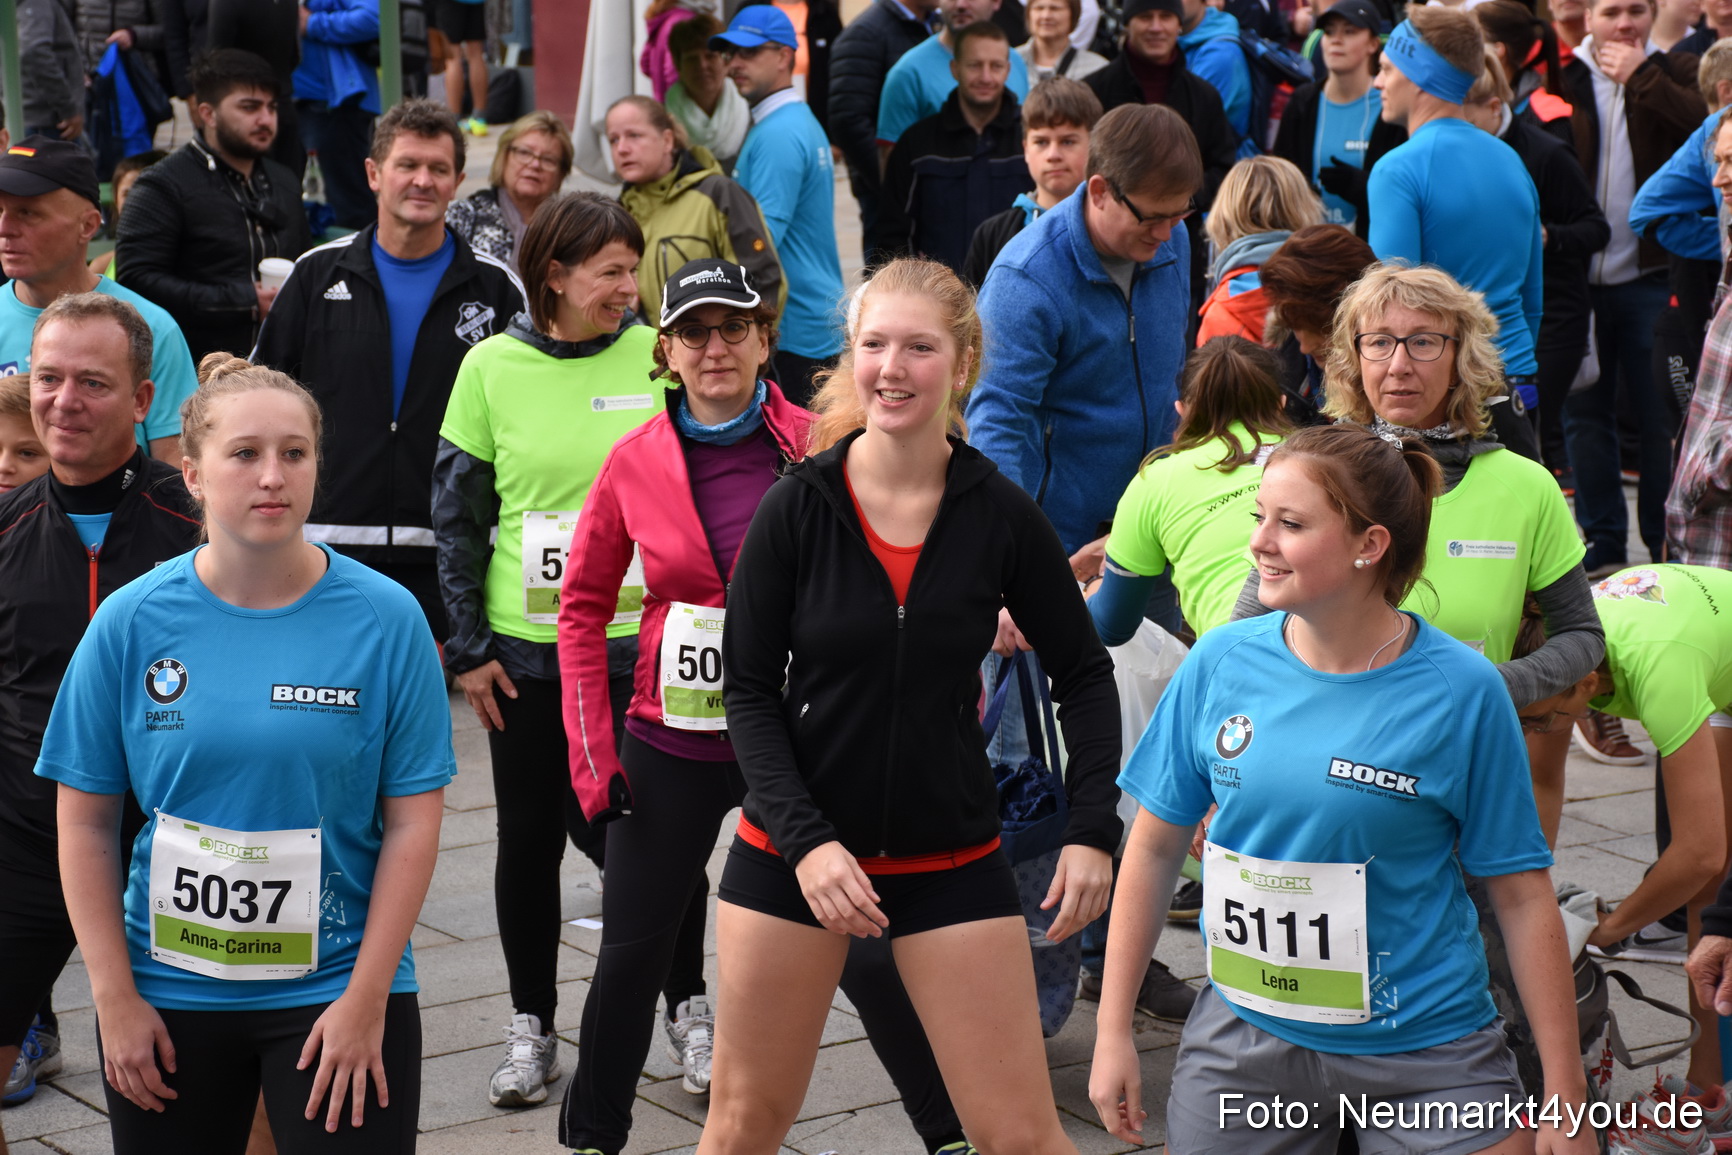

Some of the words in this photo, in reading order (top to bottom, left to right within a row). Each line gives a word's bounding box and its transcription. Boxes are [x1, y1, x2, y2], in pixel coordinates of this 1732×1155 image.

[696, 276, 731, 284] Marathon
[324, 292, 352, 300] adidas
[471, 326, 484, 341] SV
[150, 660, 185, 675] BMW
[271, 684, 361, 708] BOCK
[145, 711, 185, 722] PARTL
[146, 722, 185, 731] Neumarkt
[1213, 763, 1242, 780] PARTL
[1328, 757, 1421, 797] BOCK
[1214, 777, 1241, 789] Neumarkt
[1325, 777, 1354, 789] inspired
[1356, 784, 1365, 793] by
[1366, 788, 1387, 798] smart
[214, 840, 269, 859] BOCK
[1253, 872, 1312, 890] BOCK
[172, 866, 292, 924] 5037
[322, 890, 335, 910] 2017
[157, 900, 164, 909] S
[1212, 932, 1219, 942] S
[1224, 898, 1330, 960] 5111
[180, 928, 282, 954] Anna-Carina
[1261, 968, 1299, 992] Lena
[1372, 976, 1389, 993] 2017
